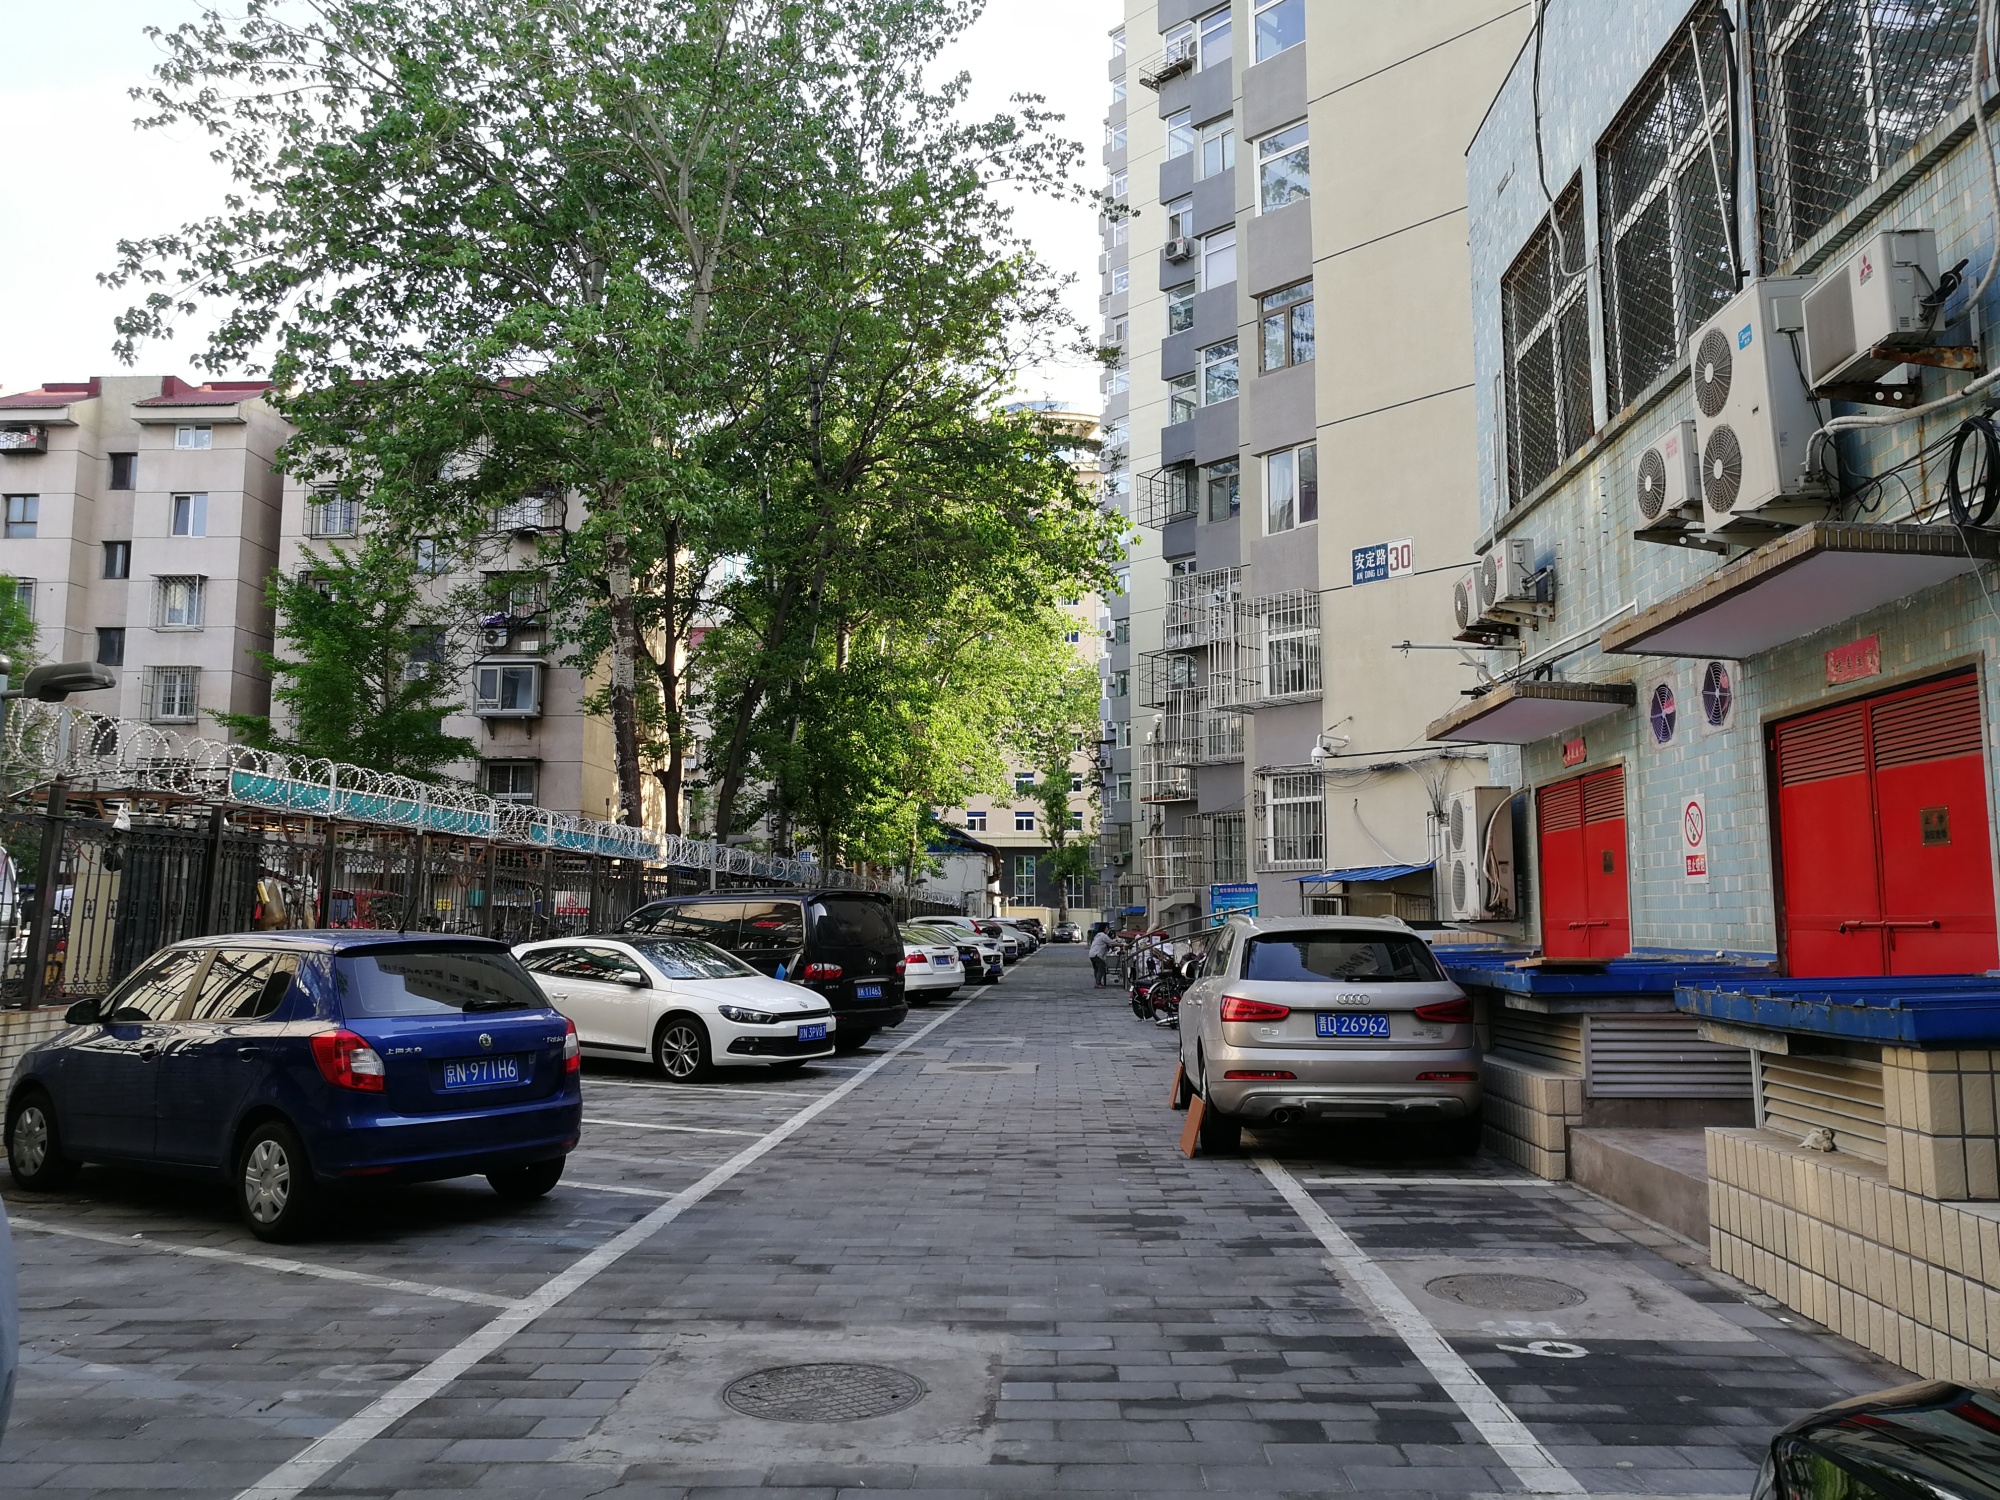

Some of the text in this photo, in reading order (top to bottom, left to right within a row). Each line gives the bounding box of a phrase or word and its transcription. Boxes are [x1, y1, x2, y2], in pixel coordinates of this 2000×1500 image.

[1354, 548, 1387, 571] 安定路
[1389, 544, 1411, 572] 30
[1376, 567, 1384, 577] LU
